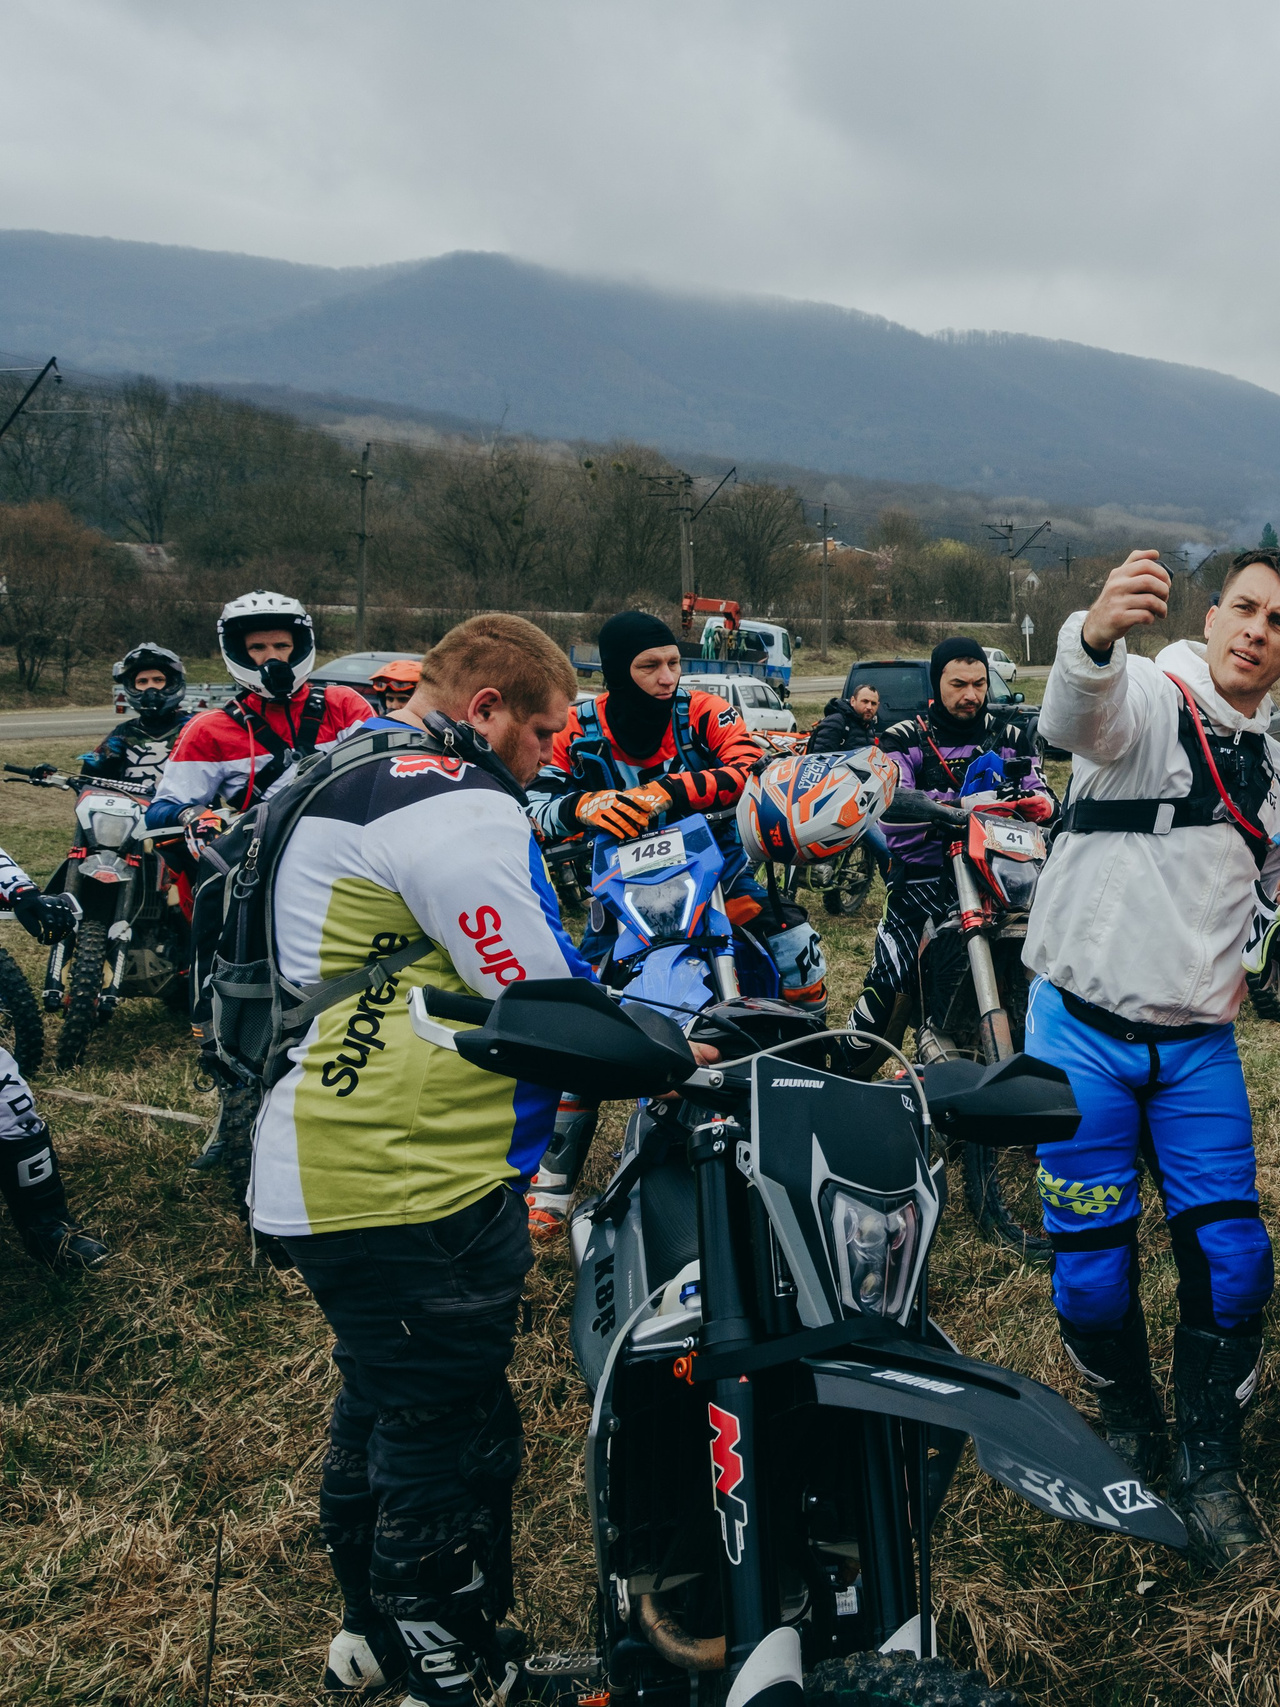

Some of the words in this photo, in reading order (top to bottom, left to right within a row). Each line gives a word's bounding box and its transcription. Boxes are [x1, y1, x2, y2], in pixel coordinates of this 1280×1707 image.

[1006, 832, 1023, 845] 41
[631, 840, 671, 862] 148
[458, 905, 526, 987] Sup
[771, 1078, 825, 1089] ZUUMAV
